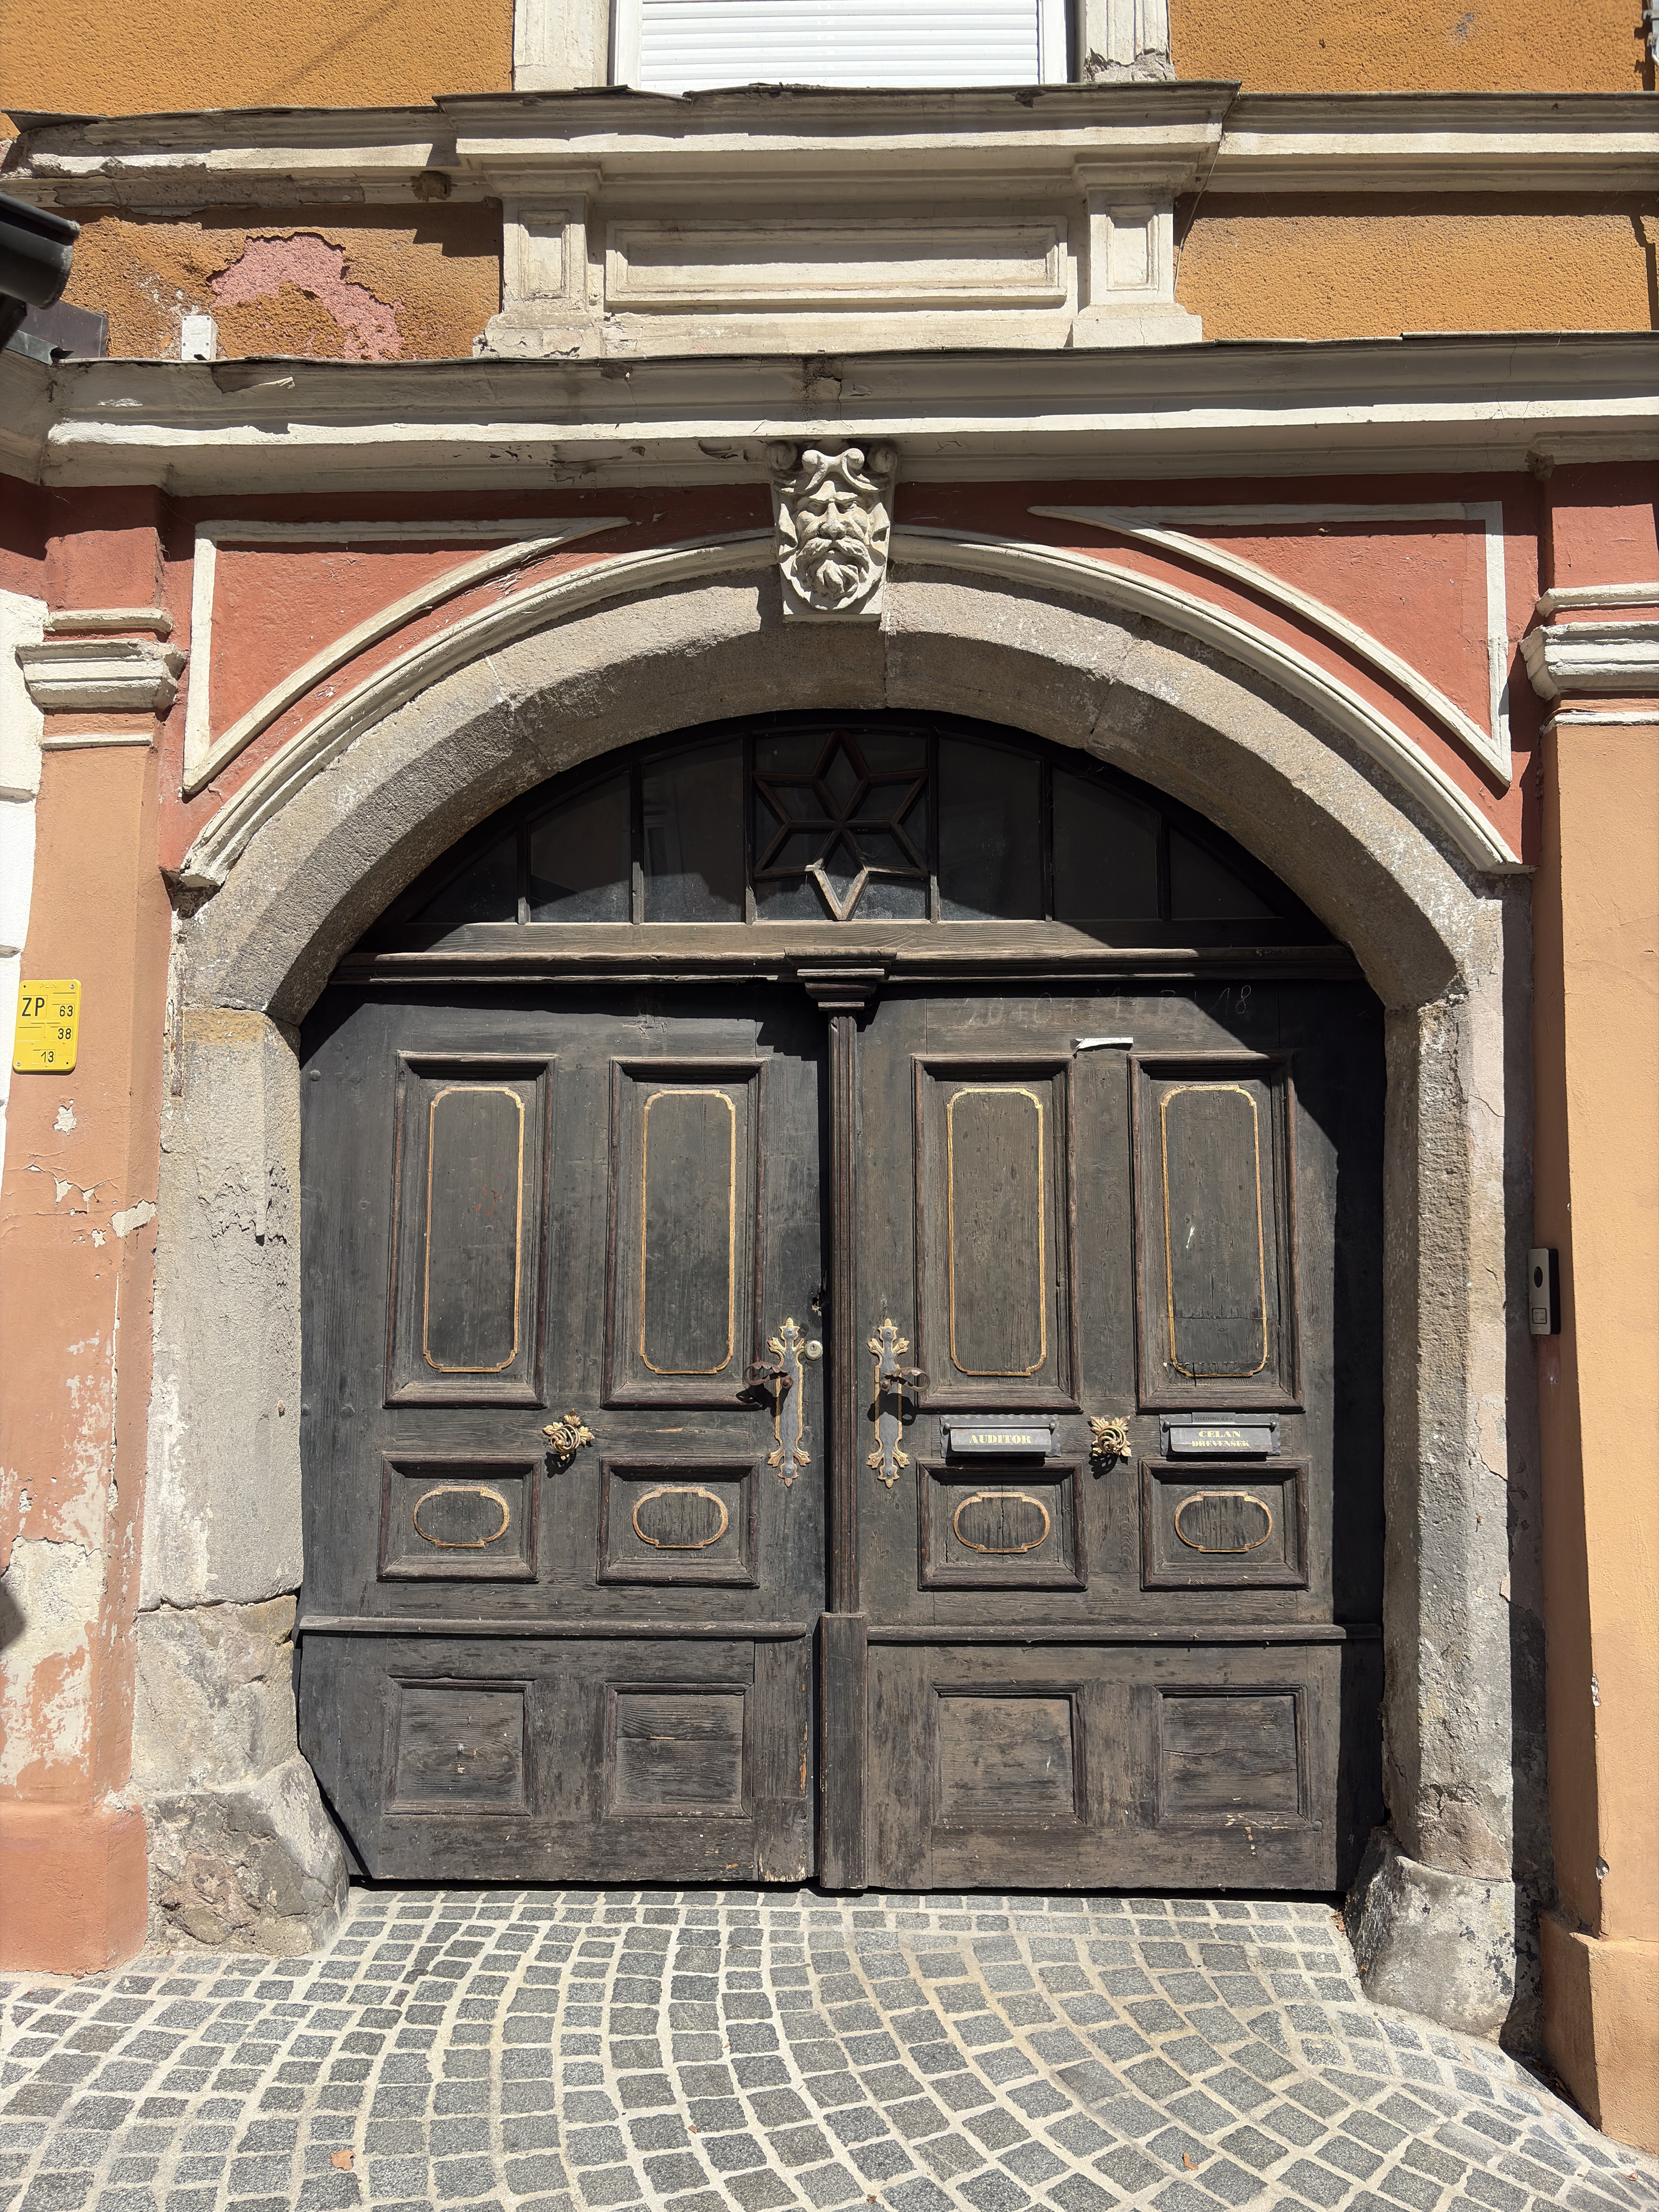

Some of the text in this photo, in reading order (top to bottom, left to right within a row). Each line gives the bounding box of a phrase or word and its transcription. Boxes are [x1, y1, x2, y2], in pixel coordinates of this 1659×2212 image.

[22, 997, 45, 1017] ZP
[59, 1005, 74, 1017] 63
[58, 1028, 71, 1040] 38
[40, 1051, 54, 1063] 13
[969, 1434, 1032, 1444] AUDITOR
